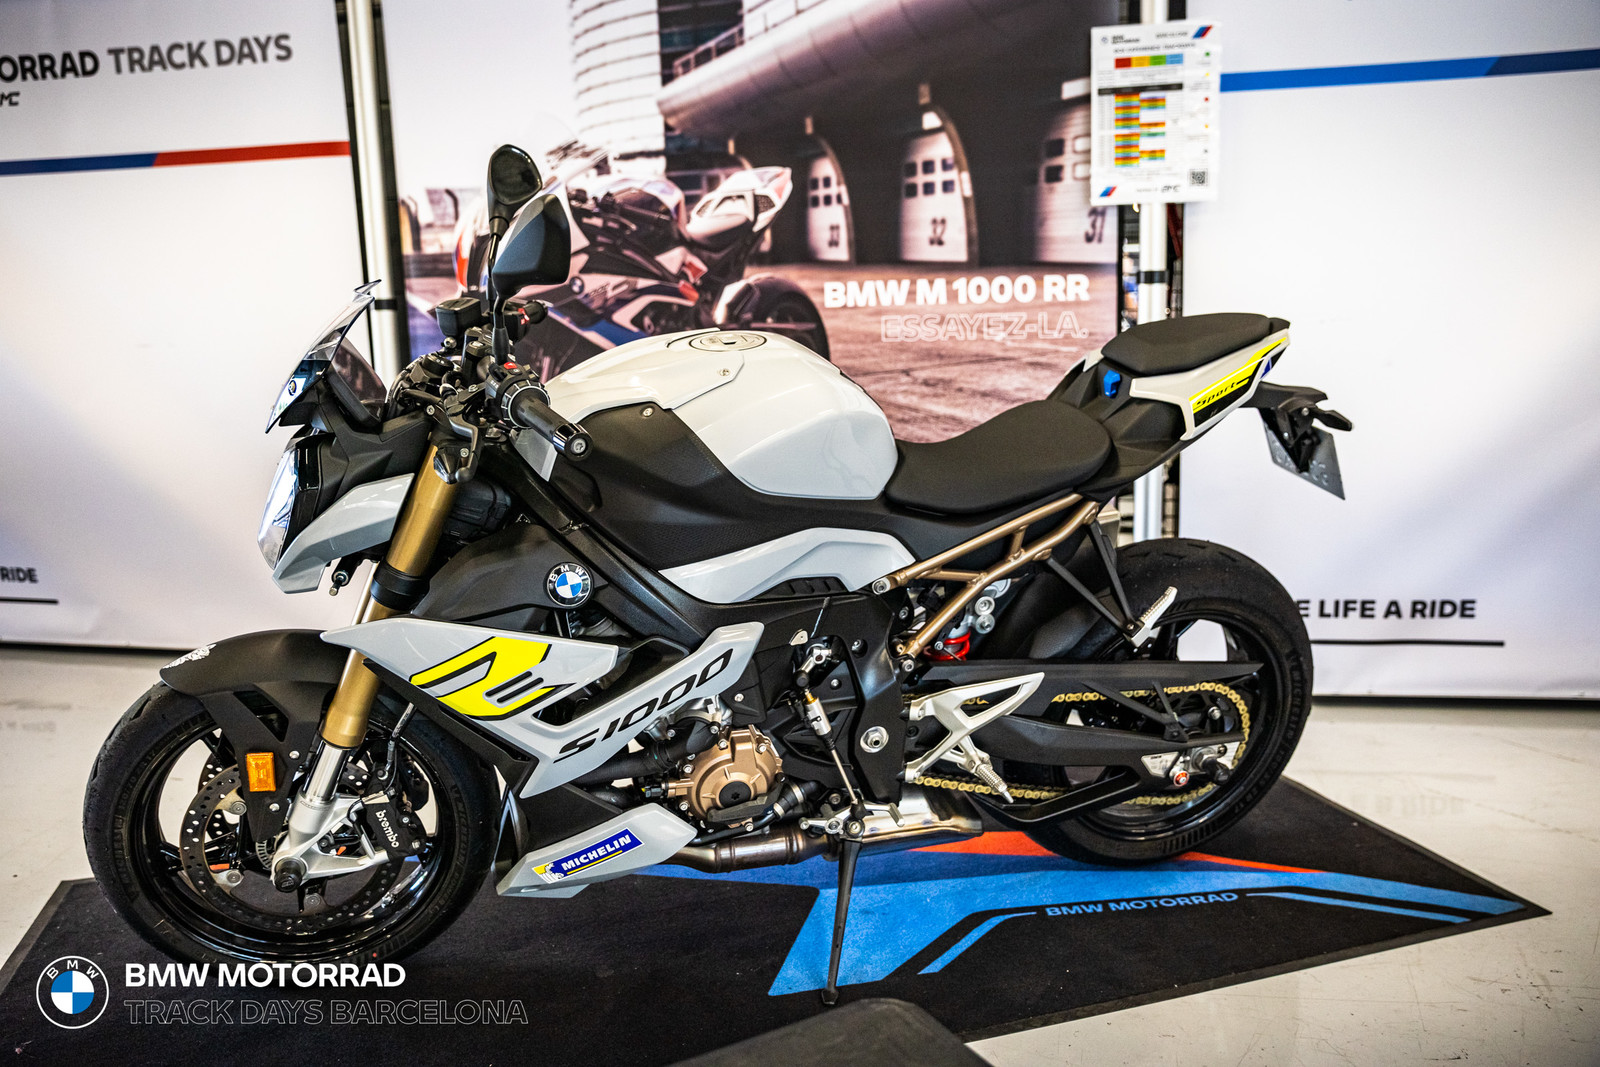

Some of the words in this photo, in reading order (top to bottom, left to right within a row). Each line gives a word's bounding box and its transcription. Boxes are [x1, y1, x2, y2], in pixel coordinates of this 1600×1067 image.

[0, 49, 100, 82] ORRAD
[108, 40, 208, 75] TRACK
[215, 33, 294, 67] DAYS
[823, 279, 910, 308] BMW
[916, 277, 947, 306] M
[952, 275, 1037, 305] 1000
[1043, 273, 1090, 302] RR
[881, 310, 1090, 343] ESSAYEZ-LA.
[1196, 382, 1236, 406] Sport
[0, 566, 39, 584] RIDE
[1319, 599, 1376, 619] LIFE
[1383, 600, 1402, 619] A
[1410, 599, 1478, 619] RIDE
[375, 809, 400, 848] brembo
[561, 834, 632, 871] MICHELIN
[1044, 903, 1104, 917] BMW
[1108, 891, 1239, 912] MOTORRAD
